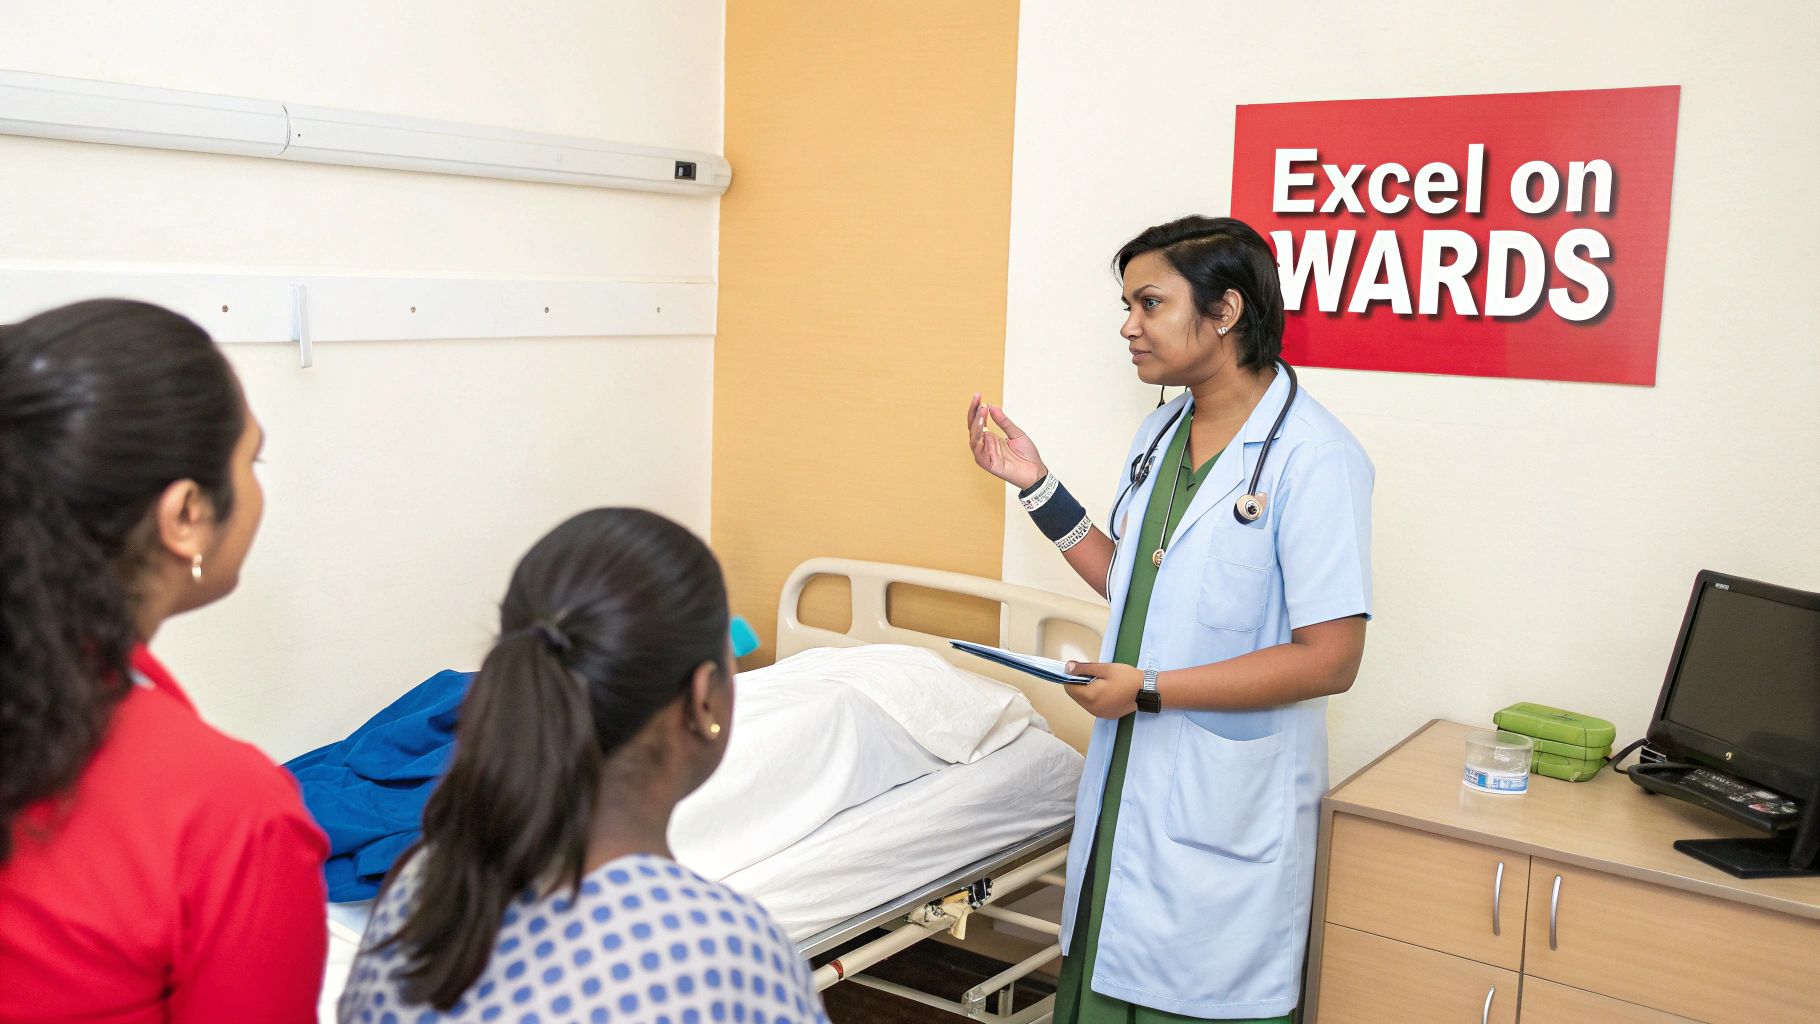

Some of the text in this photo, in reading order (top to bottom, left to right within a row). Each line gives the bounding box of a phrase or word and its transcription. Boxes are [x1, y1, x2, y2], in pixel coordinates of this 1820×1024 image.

[1272, 143, 1613, 214] Excel on
[1270, 228, 1610, 321] WARDS
